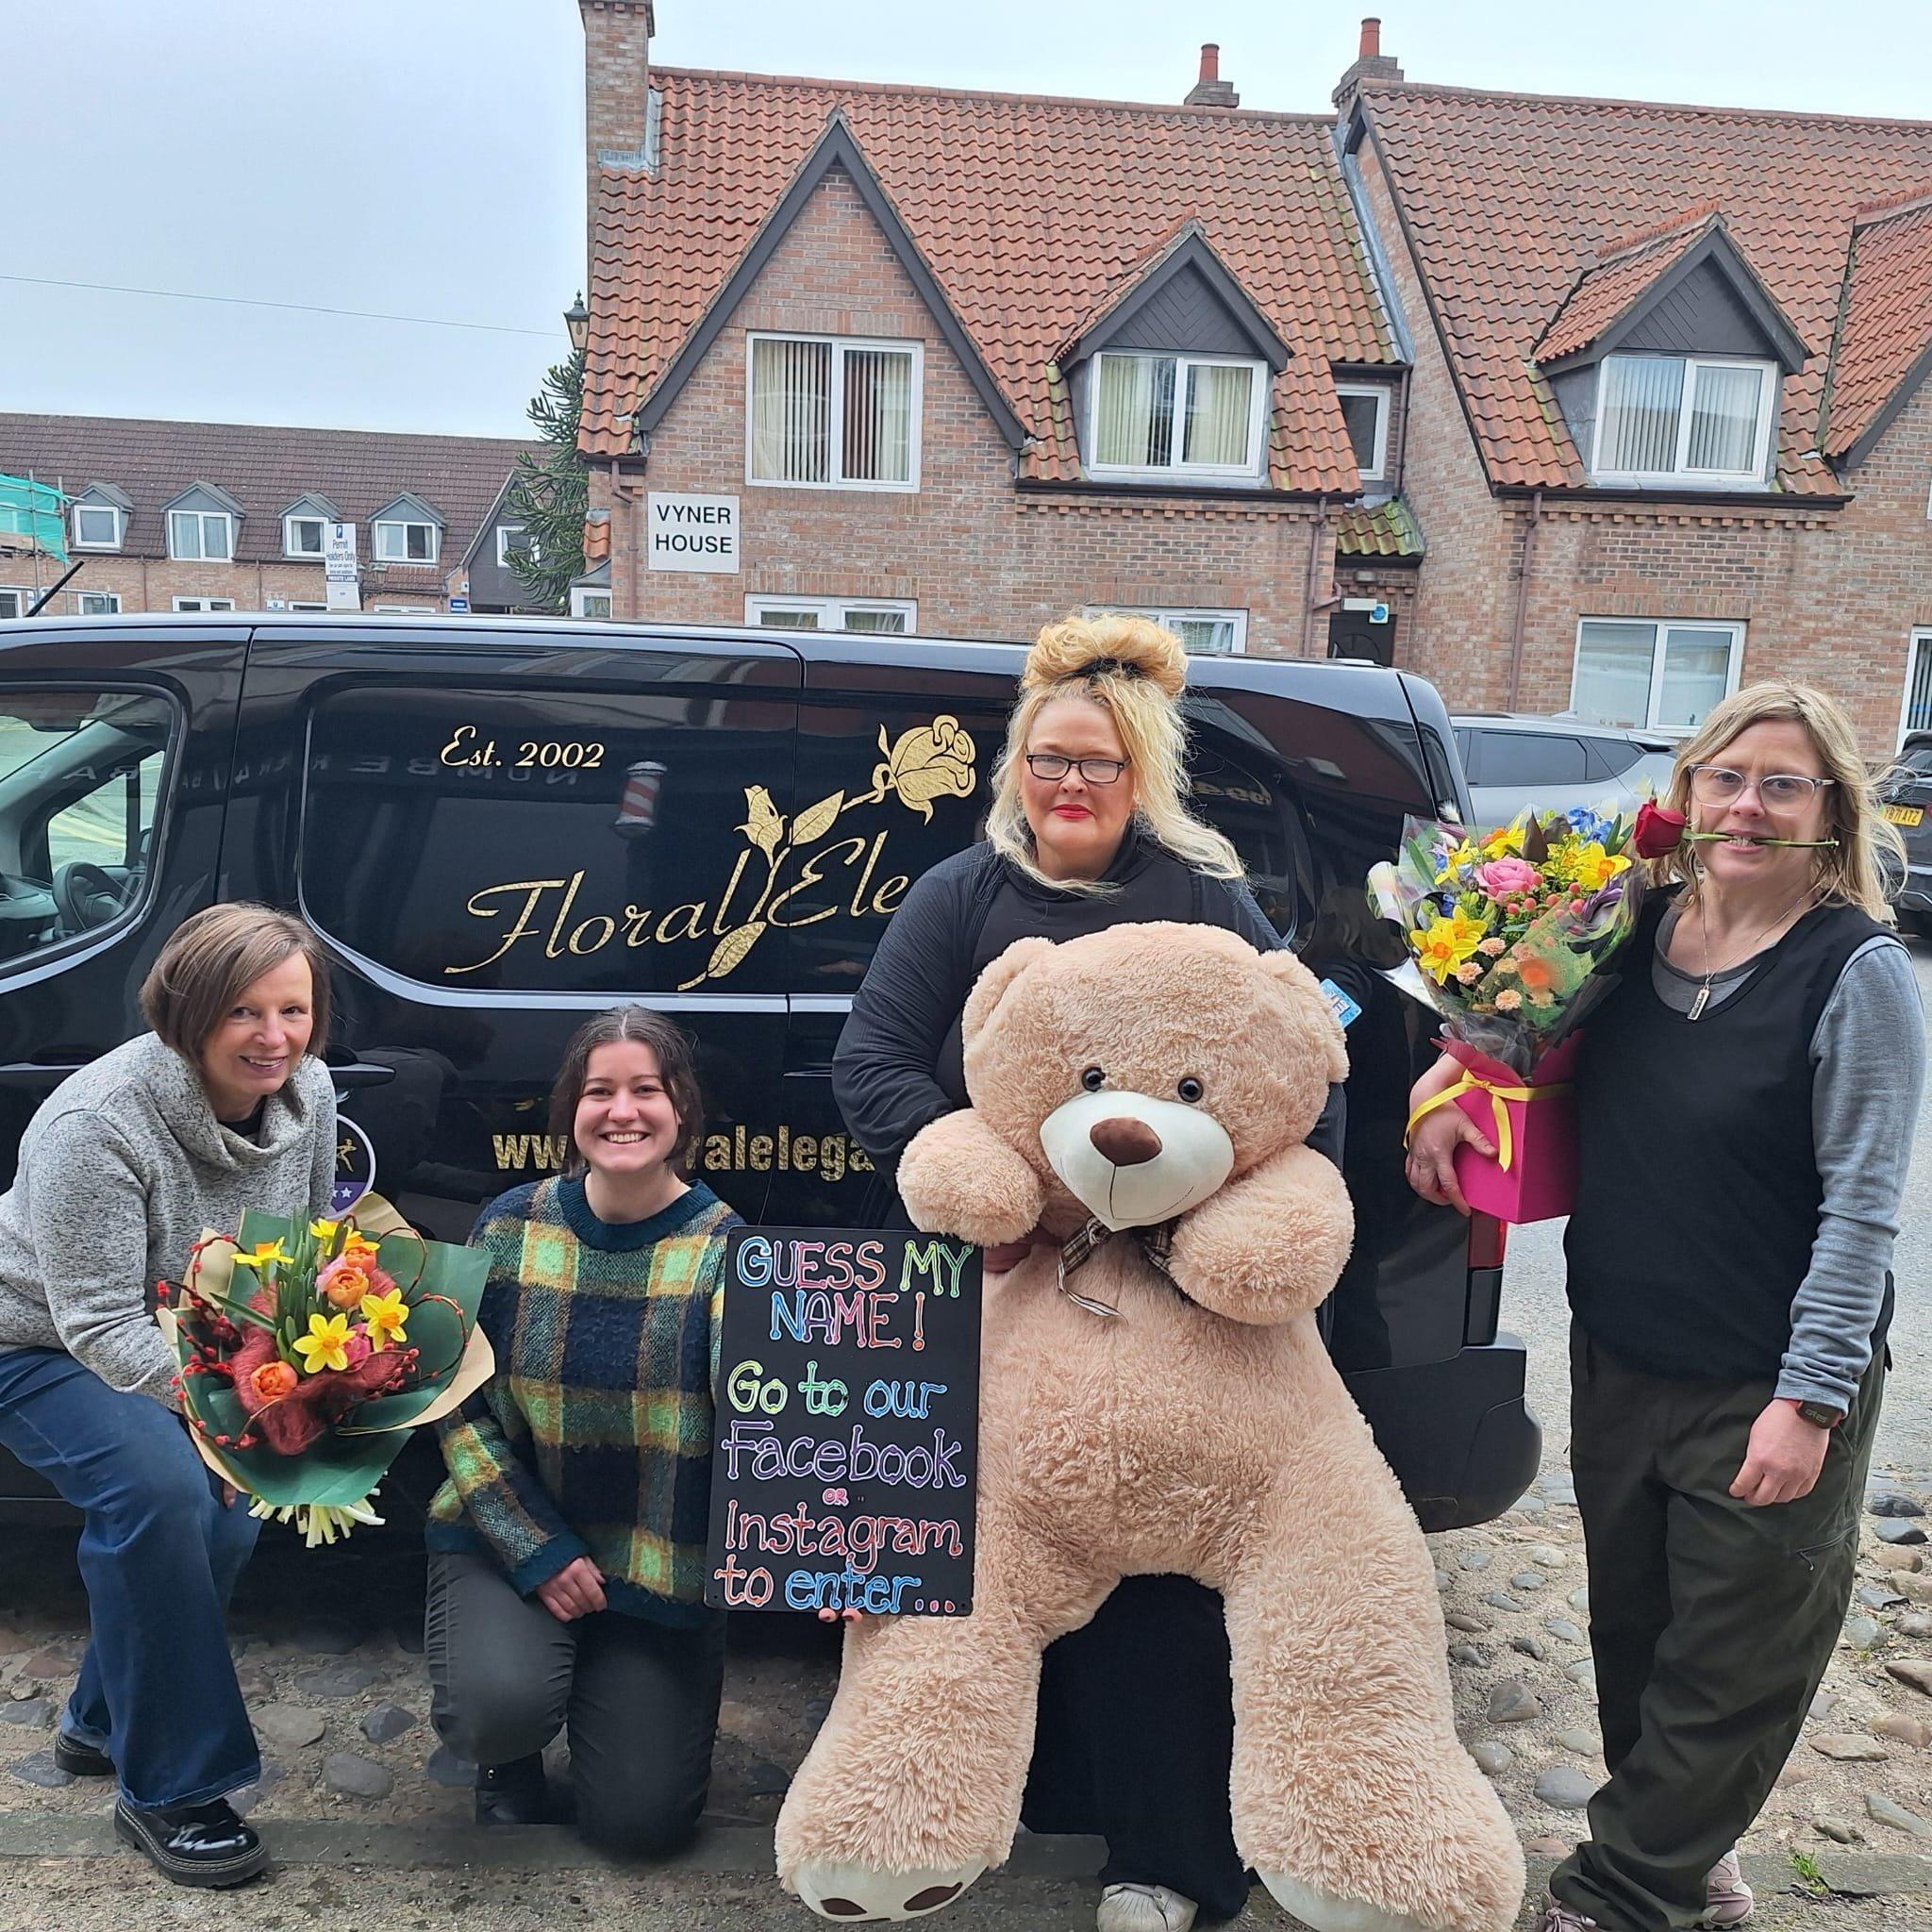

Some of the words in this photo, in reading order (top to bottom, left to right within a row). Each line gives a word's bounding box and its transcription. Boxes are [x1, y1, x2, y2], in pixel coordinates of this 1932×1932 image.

[655, 533, 733, 554] HOUSE
[656, 504, 732, 525] VYNER
[441, 725, 503, 767] Est.
[514, 741, 605, 768] 2002
[443, 848, 751, 974] Floral
[736, 1236, 887, 1291] GUESS
[899, 1240, 974, 1298] MY
[726, 1359, 790, 1415] Go
[797, 1359, 849, 1417] to
[863, 1378, 948, 1420] our
[721, 1420, 967, 1489] Facebook
[822, 1487, 849, 1507] OR
[724, 1499, 963, 1574] Instagram
[713, 1554, 775, 1607] to
[784, 1558, 957, 1614] enter...
